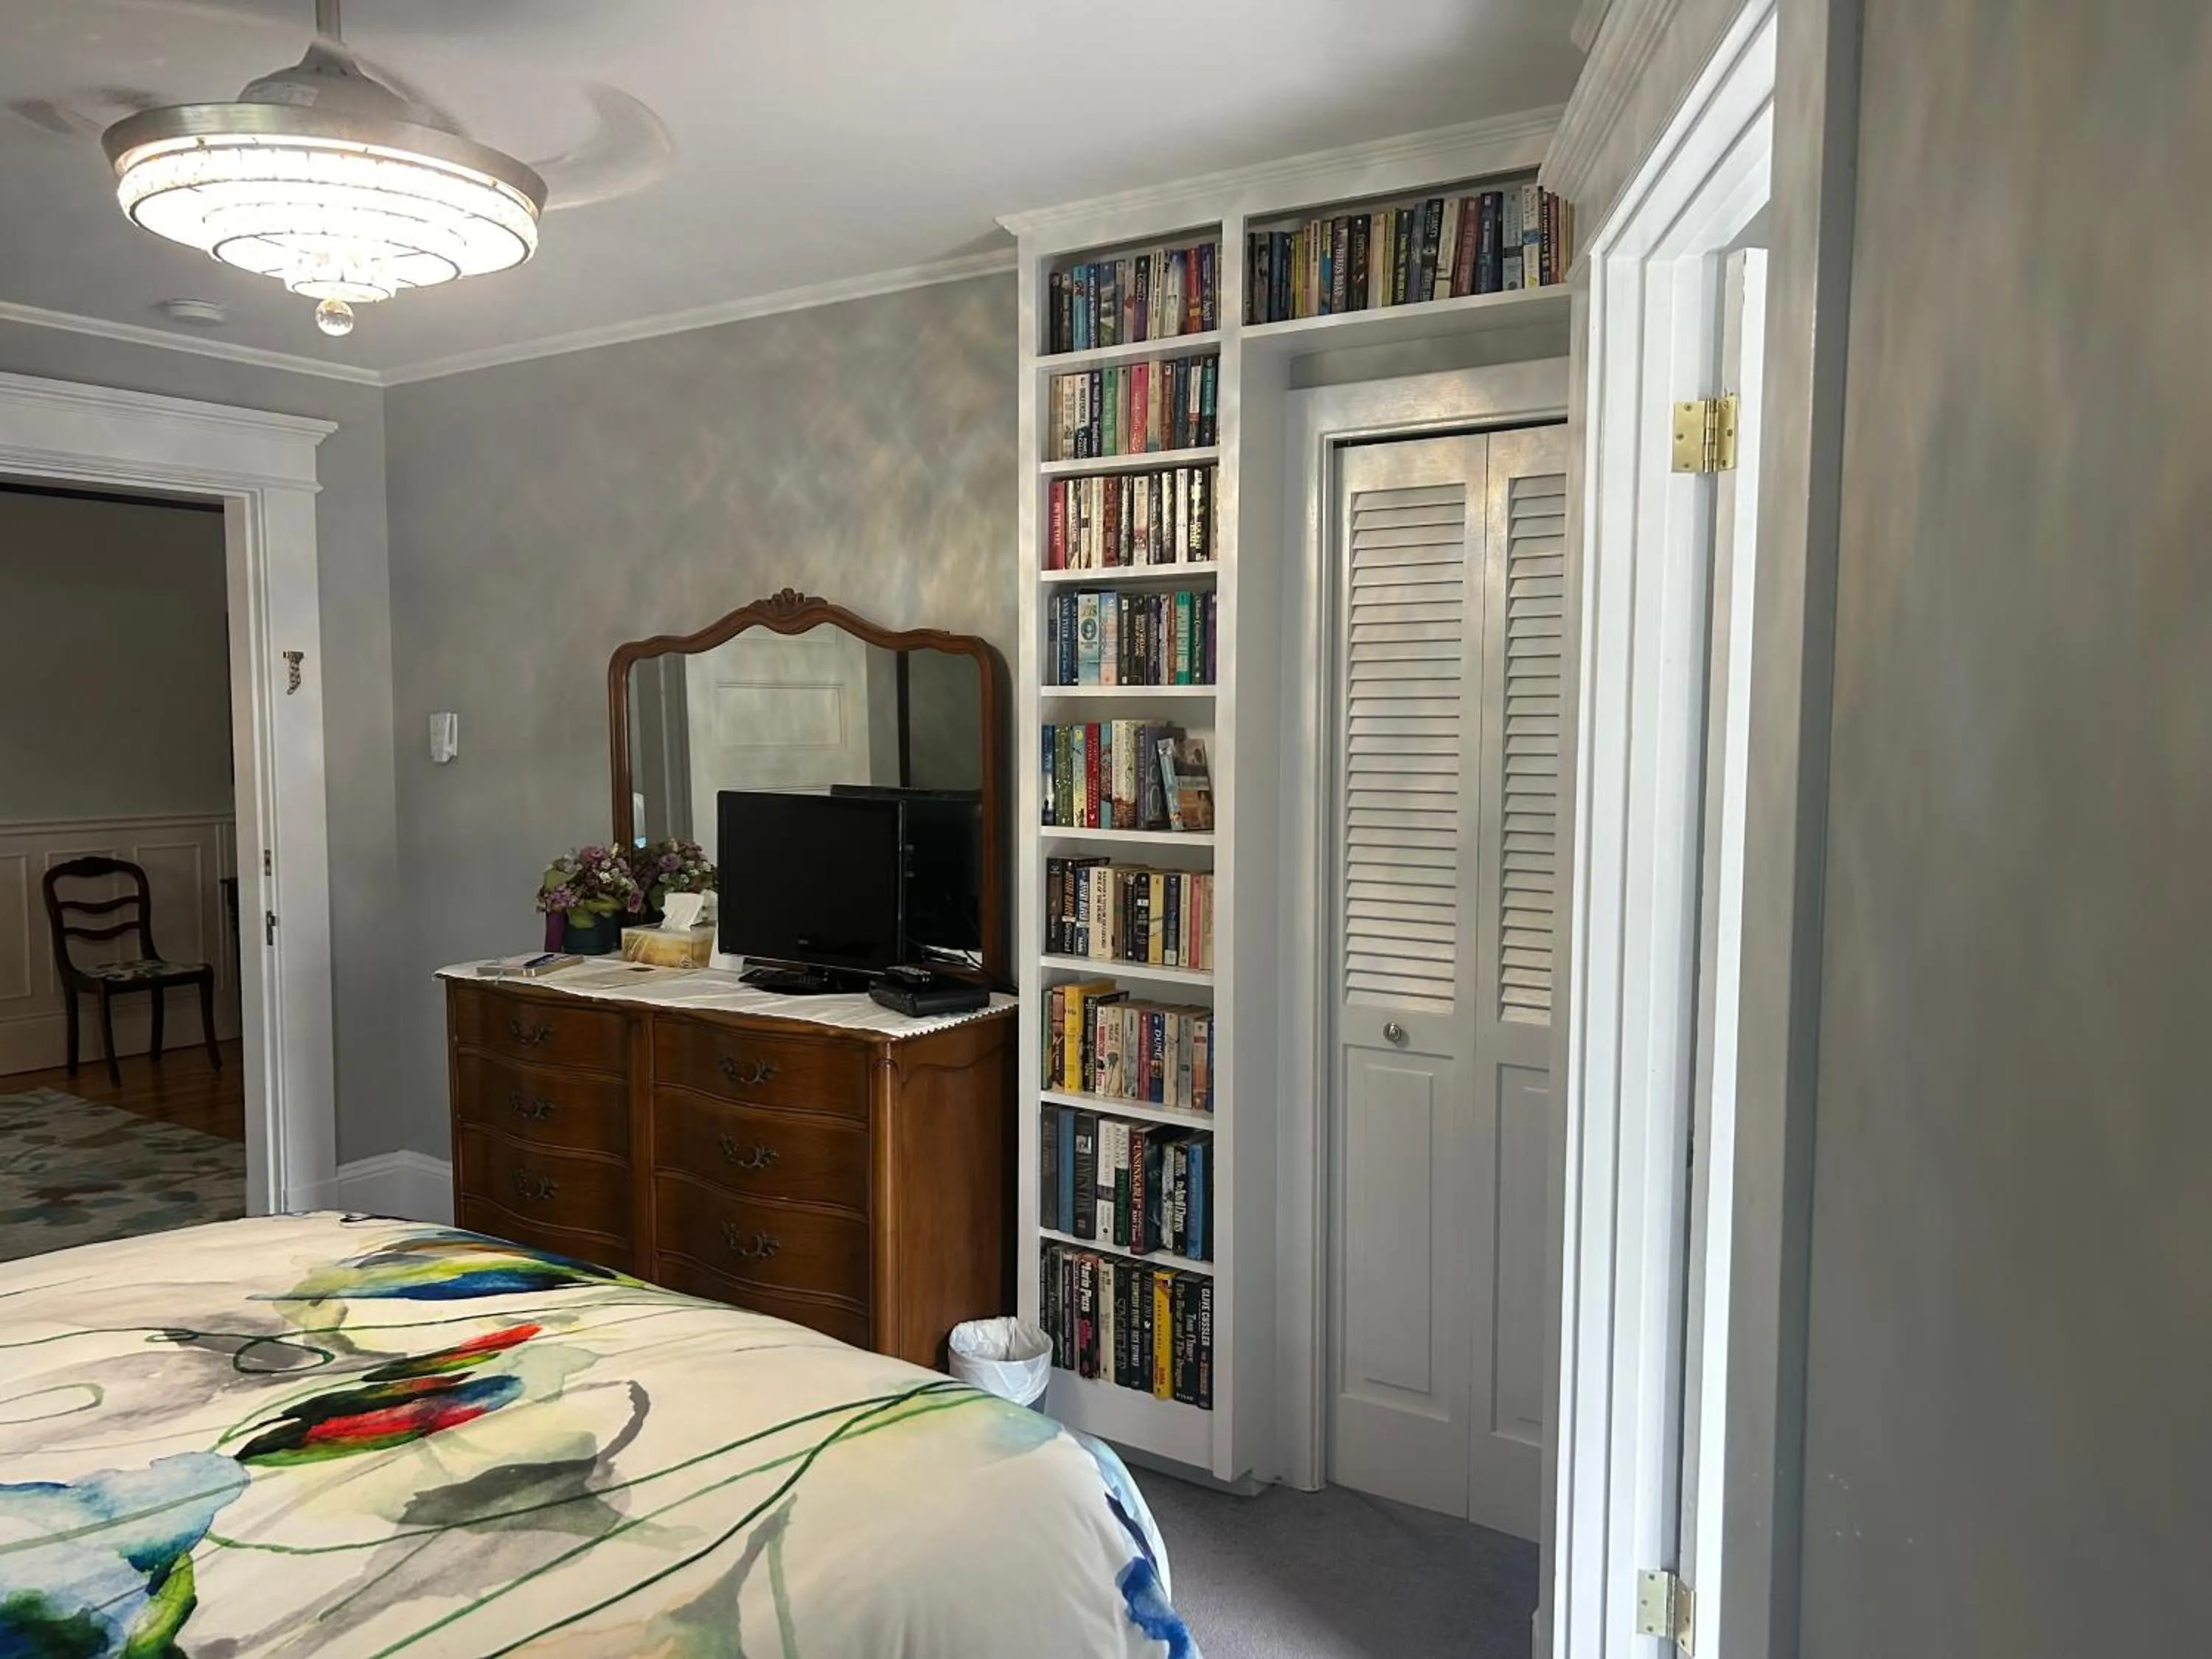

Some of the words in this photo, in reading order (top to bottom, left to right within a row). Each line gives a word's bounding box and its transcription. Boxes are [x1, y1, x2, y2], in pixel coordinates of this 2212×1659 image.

[1154, 1029, 1163, 1060] DUNE
[1079, 1261, 1092, 1288] Mario
[1079, 1287, 1092, 1312] Puzo
[1201, 1288, 1210, 1310] CLIVE
[1186, 1313, 1197, 1332] Tom
[1201, 1312, 1210, 1347] CUSSLER
[1186, 1334, 1197, 1364] Clancy
